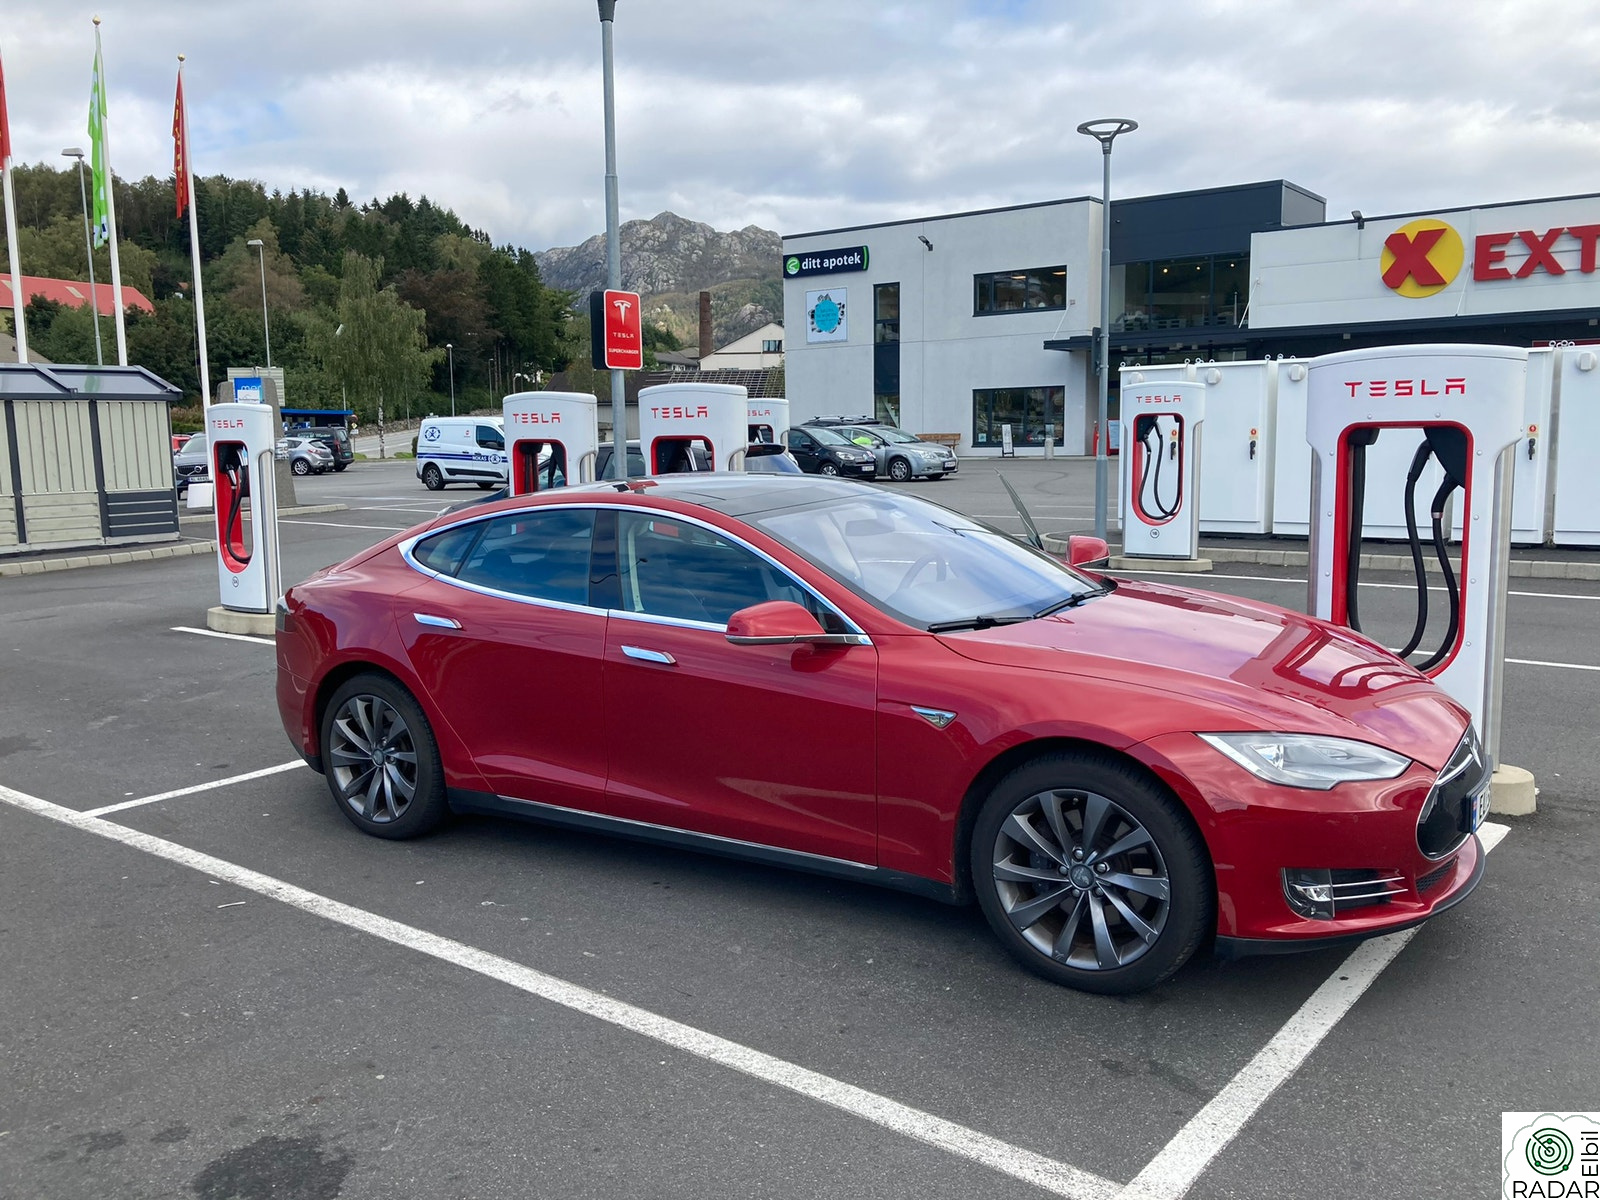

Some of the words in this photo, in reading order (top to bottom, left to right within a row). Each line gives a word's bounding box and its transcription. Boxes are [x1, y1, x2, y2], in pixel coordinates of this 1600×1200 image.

[1474, 224, 1600, 281] EXT
[802, 258, 821, 269] ditt
[823, 252, 861, 270] apotek
[608, 347, 639, 355] SUPERCHARGER
[1344, 378, 1466, 398] TESLA
[1136, 394, 1181, 404] TESLA
[512, 412, 561, 424] TESLA
[651, 406, 708, 419] TESLA
[212, 419, 243, 429] TESLA
